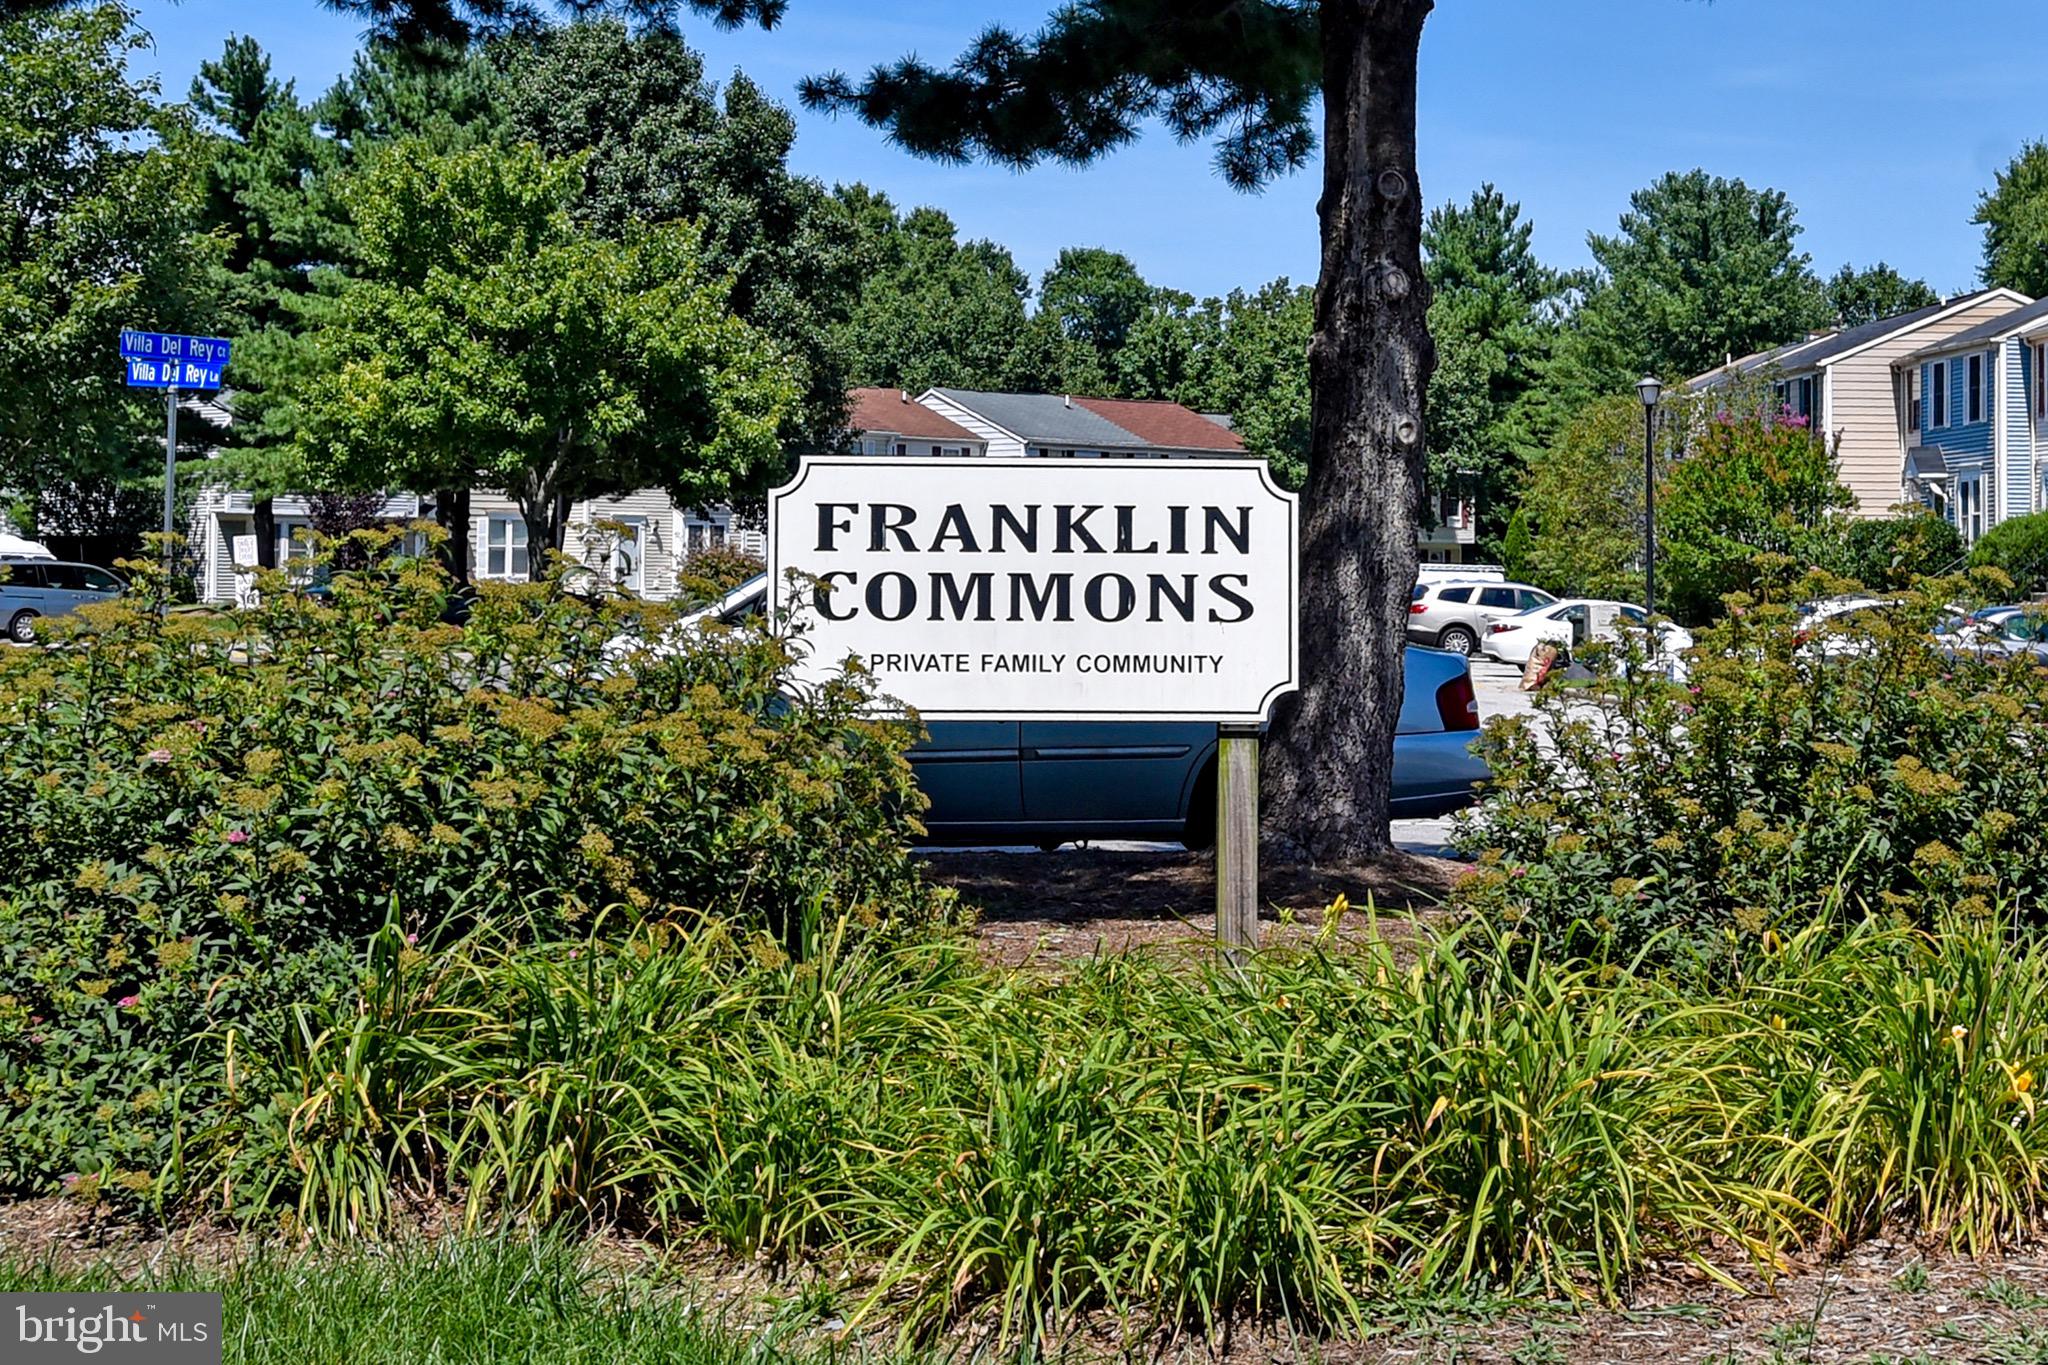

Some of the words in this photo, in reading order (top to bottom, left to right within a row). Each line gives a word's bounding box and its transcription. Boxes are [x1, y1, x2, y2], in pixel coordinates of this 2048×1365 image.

[125, 333, 153, 353] Villa
[161, 336, 181, 356] Del
[189, 338, 214, 363] Rey
[132, 362, 155, 381] Villa
[185, 364, 208, 388] Rey
[813, 502, 1254, 555] FRANKLIN
[812, 571, 1254, 623] COMMONS
[870, 653, 970, 673] PRIVATE
[981, 653, 1066, 674] FAMILY
[1076, 653, 1224, 674] COMMUNITY
